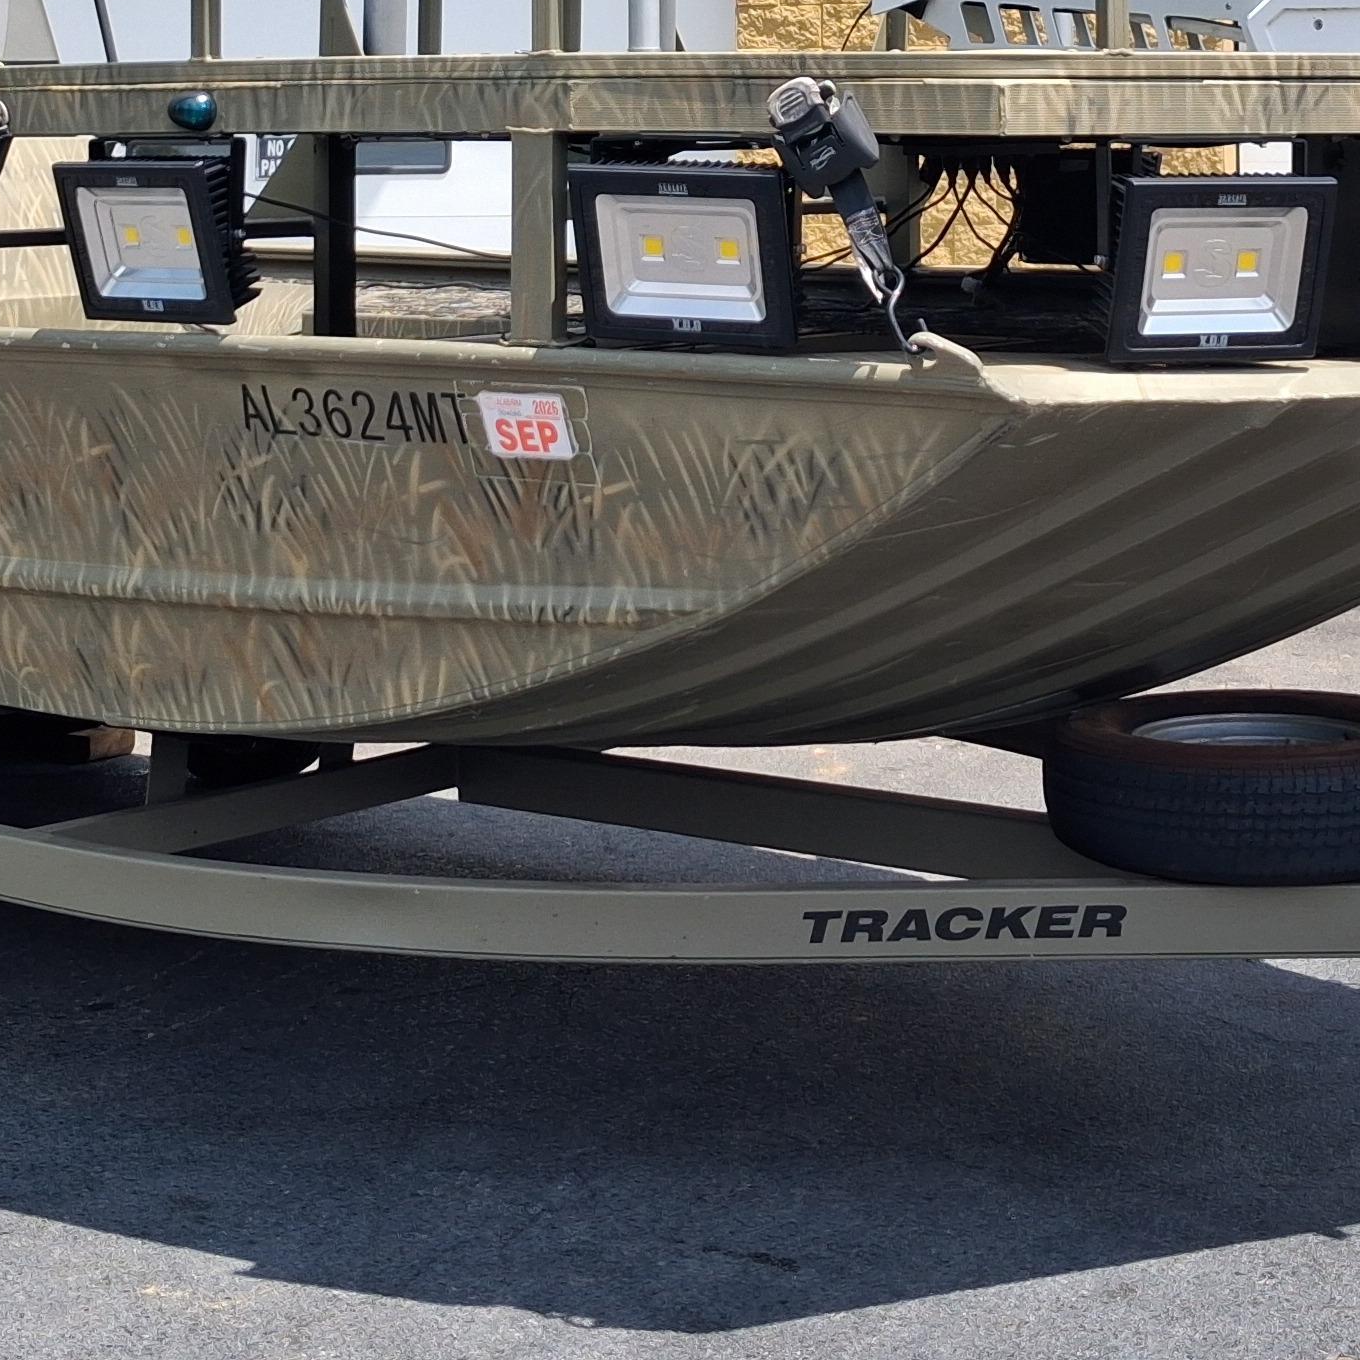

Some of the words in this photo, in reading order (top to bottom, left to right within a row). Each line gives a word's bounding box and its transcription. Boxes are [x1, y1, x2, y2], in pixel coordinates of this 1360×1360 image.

[267, 139, 285, 157] NO
[532, 400, 559, 415] 2026
[495, 418, 558, 453] SEP
[802, 904, 1127, 943] TRACKER
